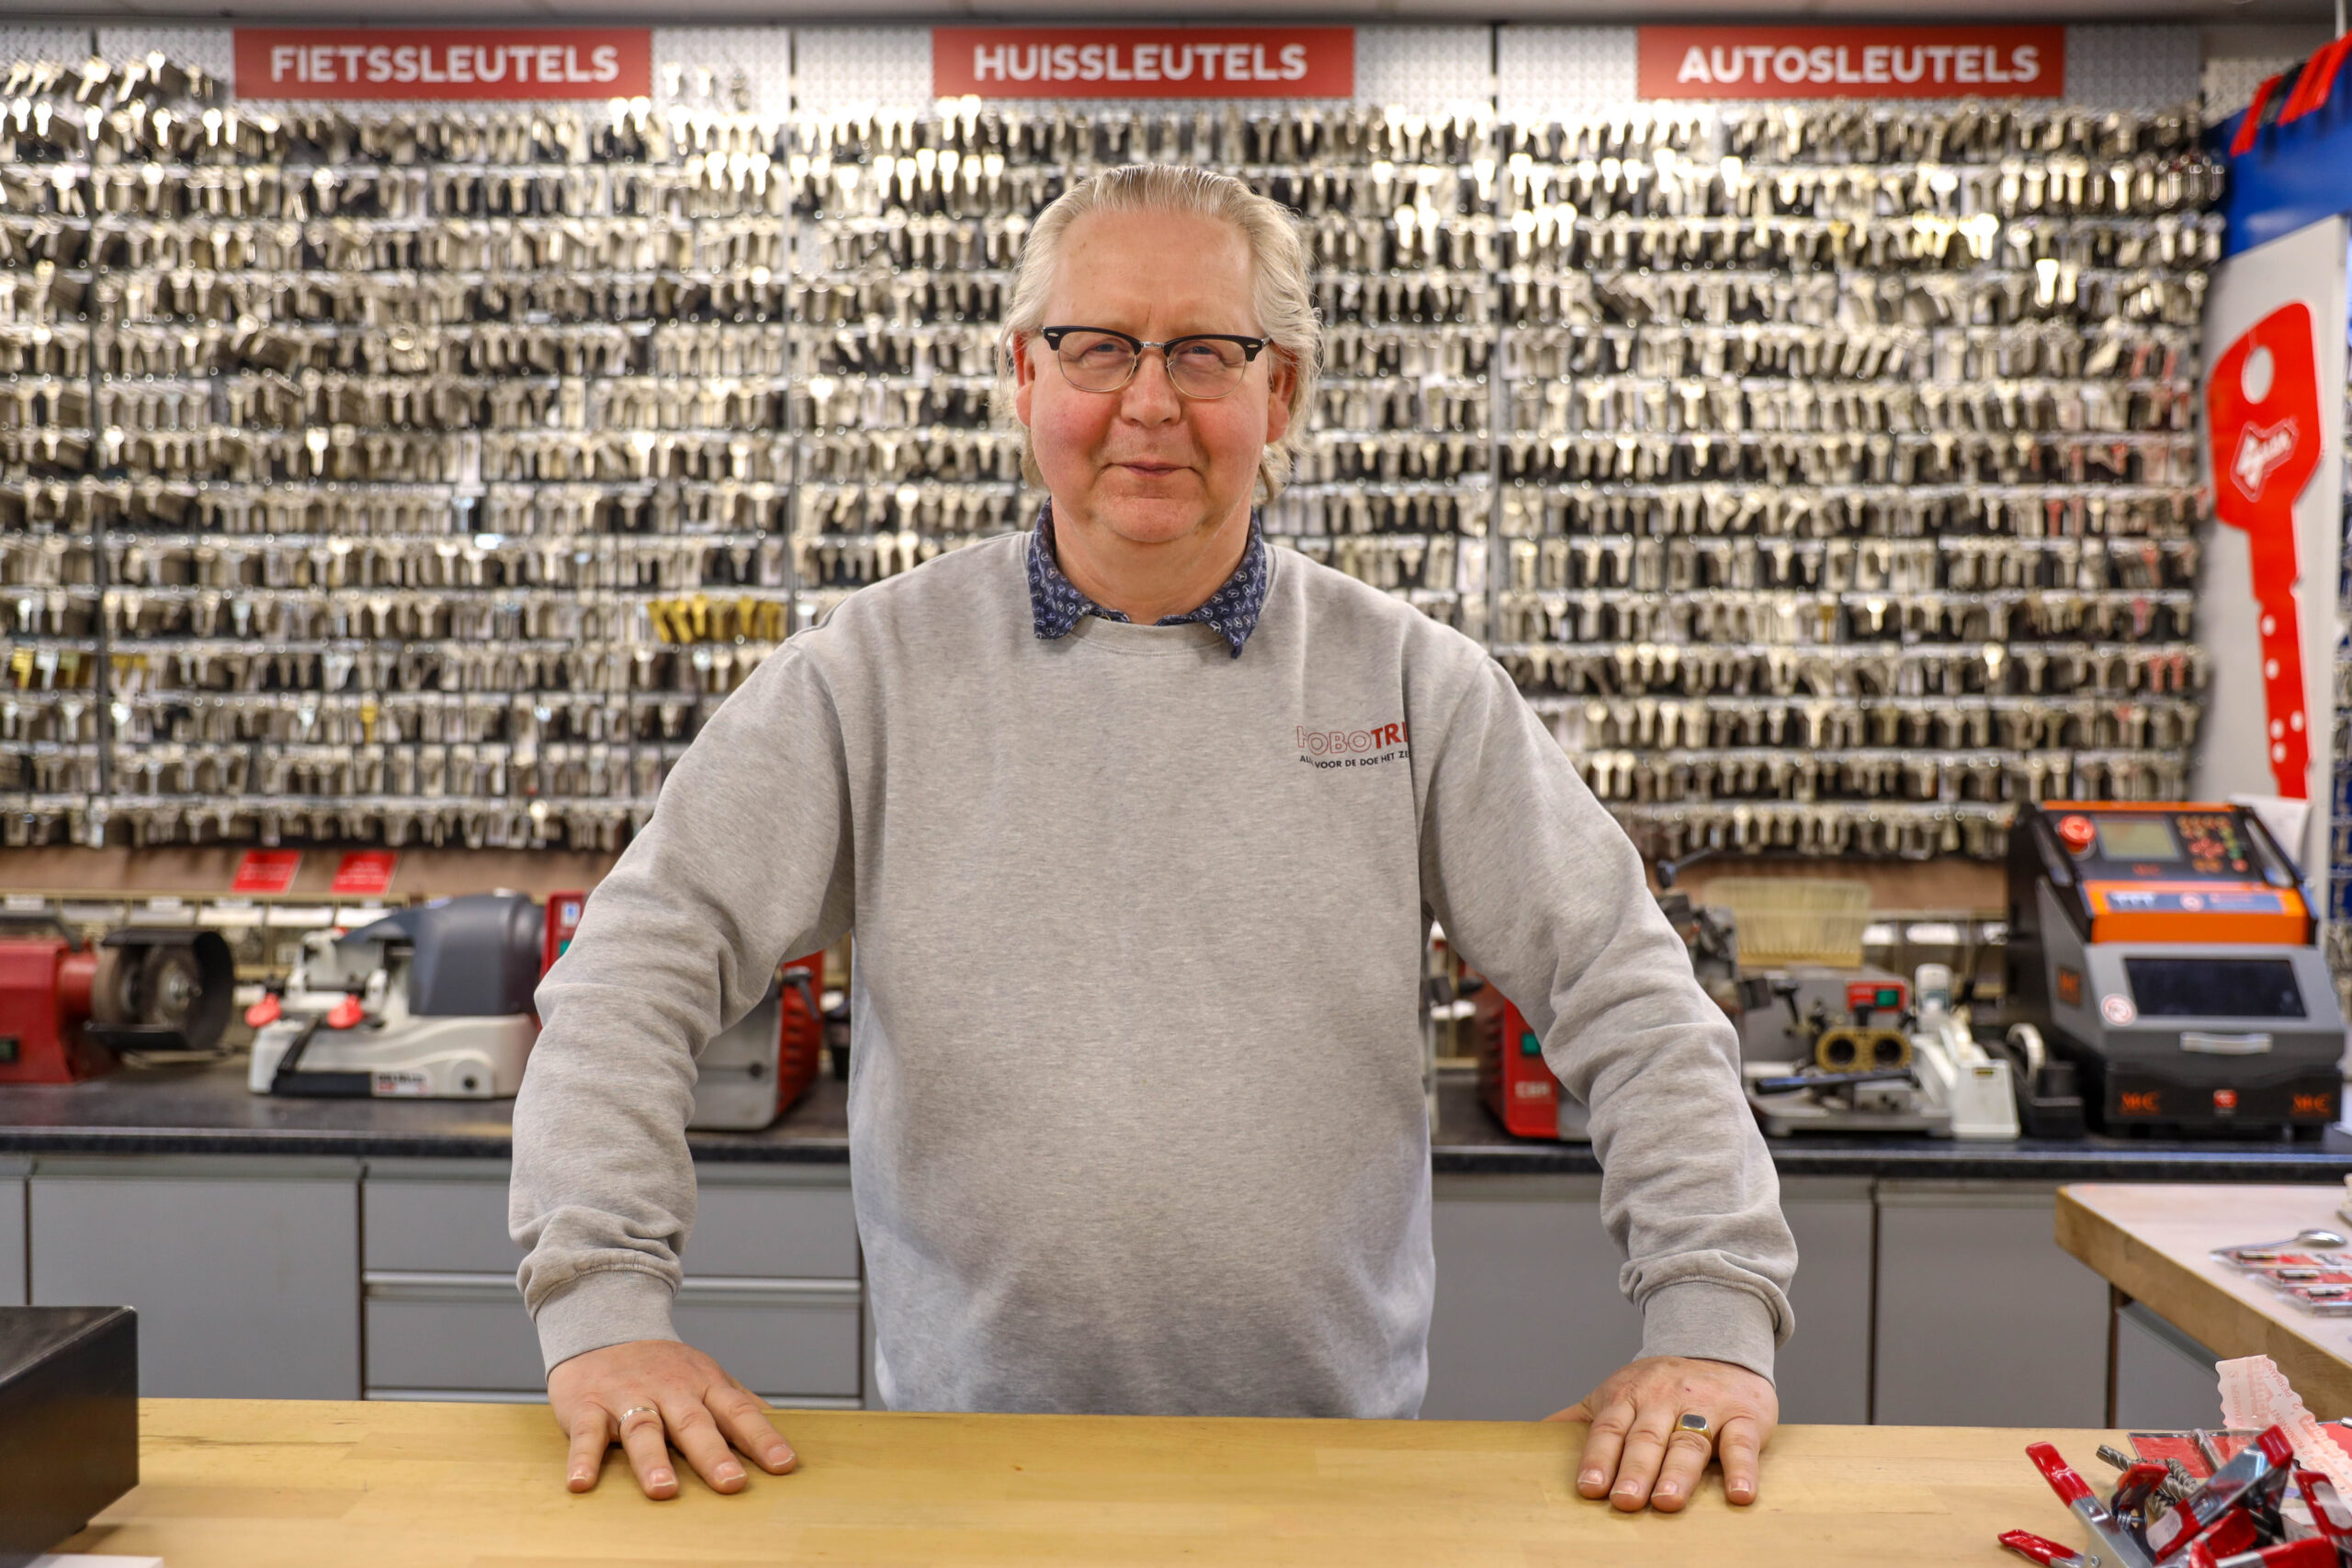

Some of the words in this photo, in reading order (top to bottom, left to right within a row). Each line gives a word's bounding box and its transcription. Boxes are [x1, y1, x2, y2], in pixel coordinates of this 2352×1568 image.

[272, 46, 619, 82] FIETSSLEUTELS
[974, 46, 1306, 81] HUISSLEUTELS
[1677, 46, 2039, 84] AUTOSLEUTELS
[1315, 761, 1342, 769] VOOR
[1345, 759, 1357, 767] DE
[1360, 758, 1379, 766] DOE
[1381, 752, 1395, 763] HET
